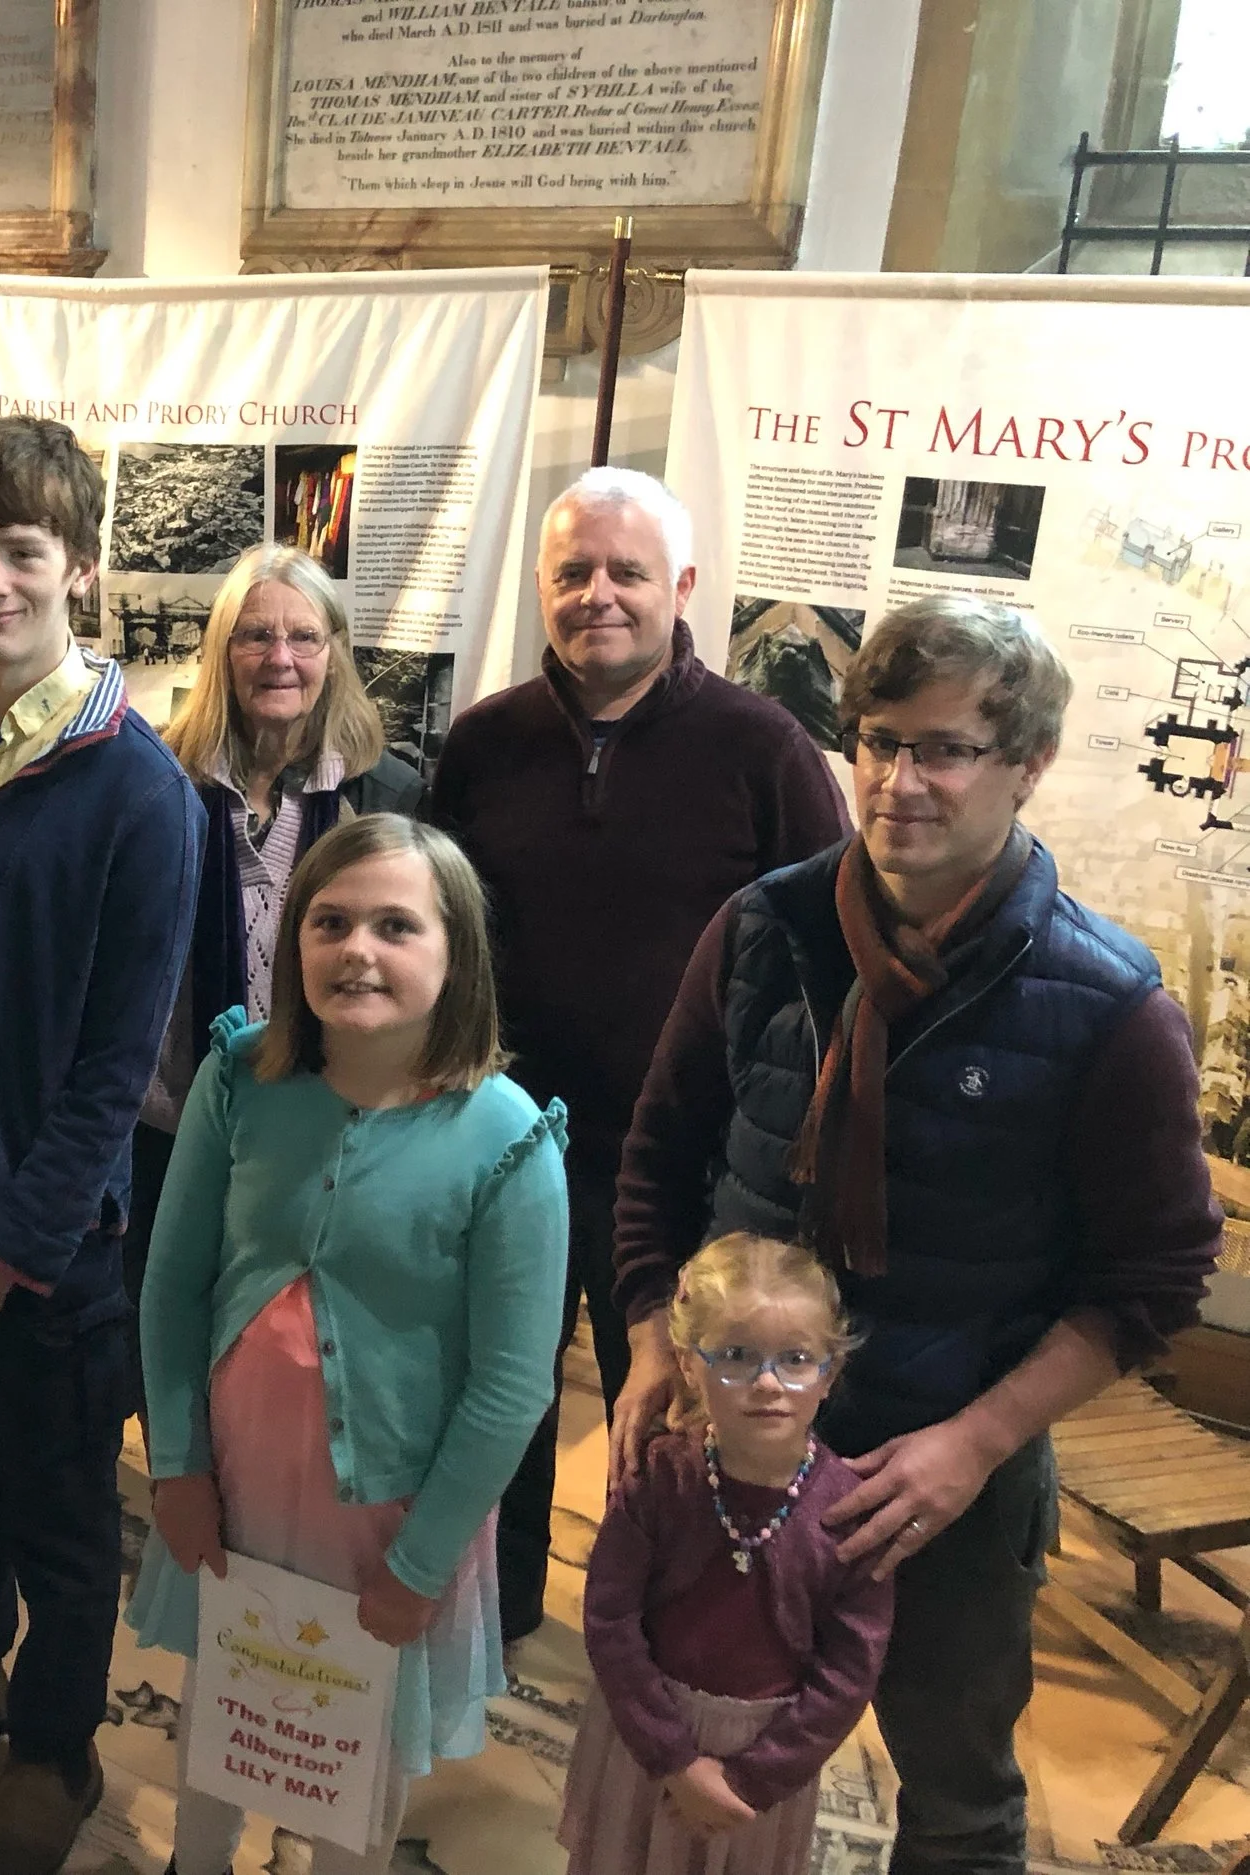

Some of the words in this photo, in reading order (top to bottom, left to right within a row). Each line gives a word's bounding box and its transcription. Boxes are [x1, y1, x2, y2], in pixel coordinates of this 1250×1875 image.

[361, 9, 382, 23] and
[388, 3, 467, 21] WILLIAM
[470, 0, 561, 16] BENTALL
[342, 28, 365, 42] who
[368, 27, 393, 41] died
[398, 24, 436, 39] March
[508, 18, 532, 33] and
[536, 19, 559, 30] was
[565, 14, 606, 28] buried
[610, 15, 623, 26] at
[448, 54, 476, 68] Also
[481, 54, 493, 65] to
[497, 51, 516, 64] the
[519, 51, 566, 64] memory
[571, 47, 582, 61] of
[291, 79, 354, 94] LOUISA
[459, 75, 479, 86] one
[483, 70, 496, 85] of
[500, 69, 519, 83] the
[522, 71, 542, 82] two
[546, 67, 596, 81] children
[601, 64, 615, 78] of
[618, 64, 638, 77] the
[644, 62, 682, 75] above
[687, 57, 758, 74] mentioned
[310, 94, 381, 110] THOMAS
[483, 91, 506, 103] and
[510, 88, 542, 101] sister
[547, 86, 561, 100] of
[566, 82, 654, 99] SYBILLA
[660, 81, 686, 95] wife
[693, 79, 707, 93] of
[713, 78, 733, 92] the
[318, 110, 387, 127] CLAUDE
[390, 107, 484, 125] JAMINEAU
[573, 103, 612, 118] Rector
[616, 102, 632, 117] of
[633, 101, 667, 115] Great
[285, 133, 305, 145] She
[309, 131, 332, 144] died
[335, 132, 345, 143] in
[397, 128, 448, 144] January
[491, 125, 526, 138] 1810
[532, 124, 556, 137] and
[560, 126, 584, 136] was
[589, 121, 631, 136] buried
[637, 120, 676, 135] within
[680, 119, 704, 133] this
[710, 117, 757, 132] church
[337, 149, 374, 161] beside
[378, 148, 397, 160] her
[402, 146, 476, 163] grandmother
[481, 141, 593, 159] ELIZABETH
[385, 176, 417, 190] which
[421, 177, 450, 193] sleep
[454, 177, 464, 189] in
[470, 175, 506, 190] Jesus
[511, 174, 533, 187] will
[538, 173, 565, 188] God
[569, 173, 604, 190] bring
[610, 171, 637, 186] with
[85, 402, 138, 424] AND
[239, 401, 358, 427] CHURCH
[747, 406, 821, 444] THE
[1180, 430, 1250, 471] PR
[217, 1627, 372, 1695] Congratulations!
[274, 1718, 327, 1750] Map
[334, 1738, 363, 1756] of
[224, 1753, 278, 1786] LILY
[284, 1775, 341, 1808] MAY
